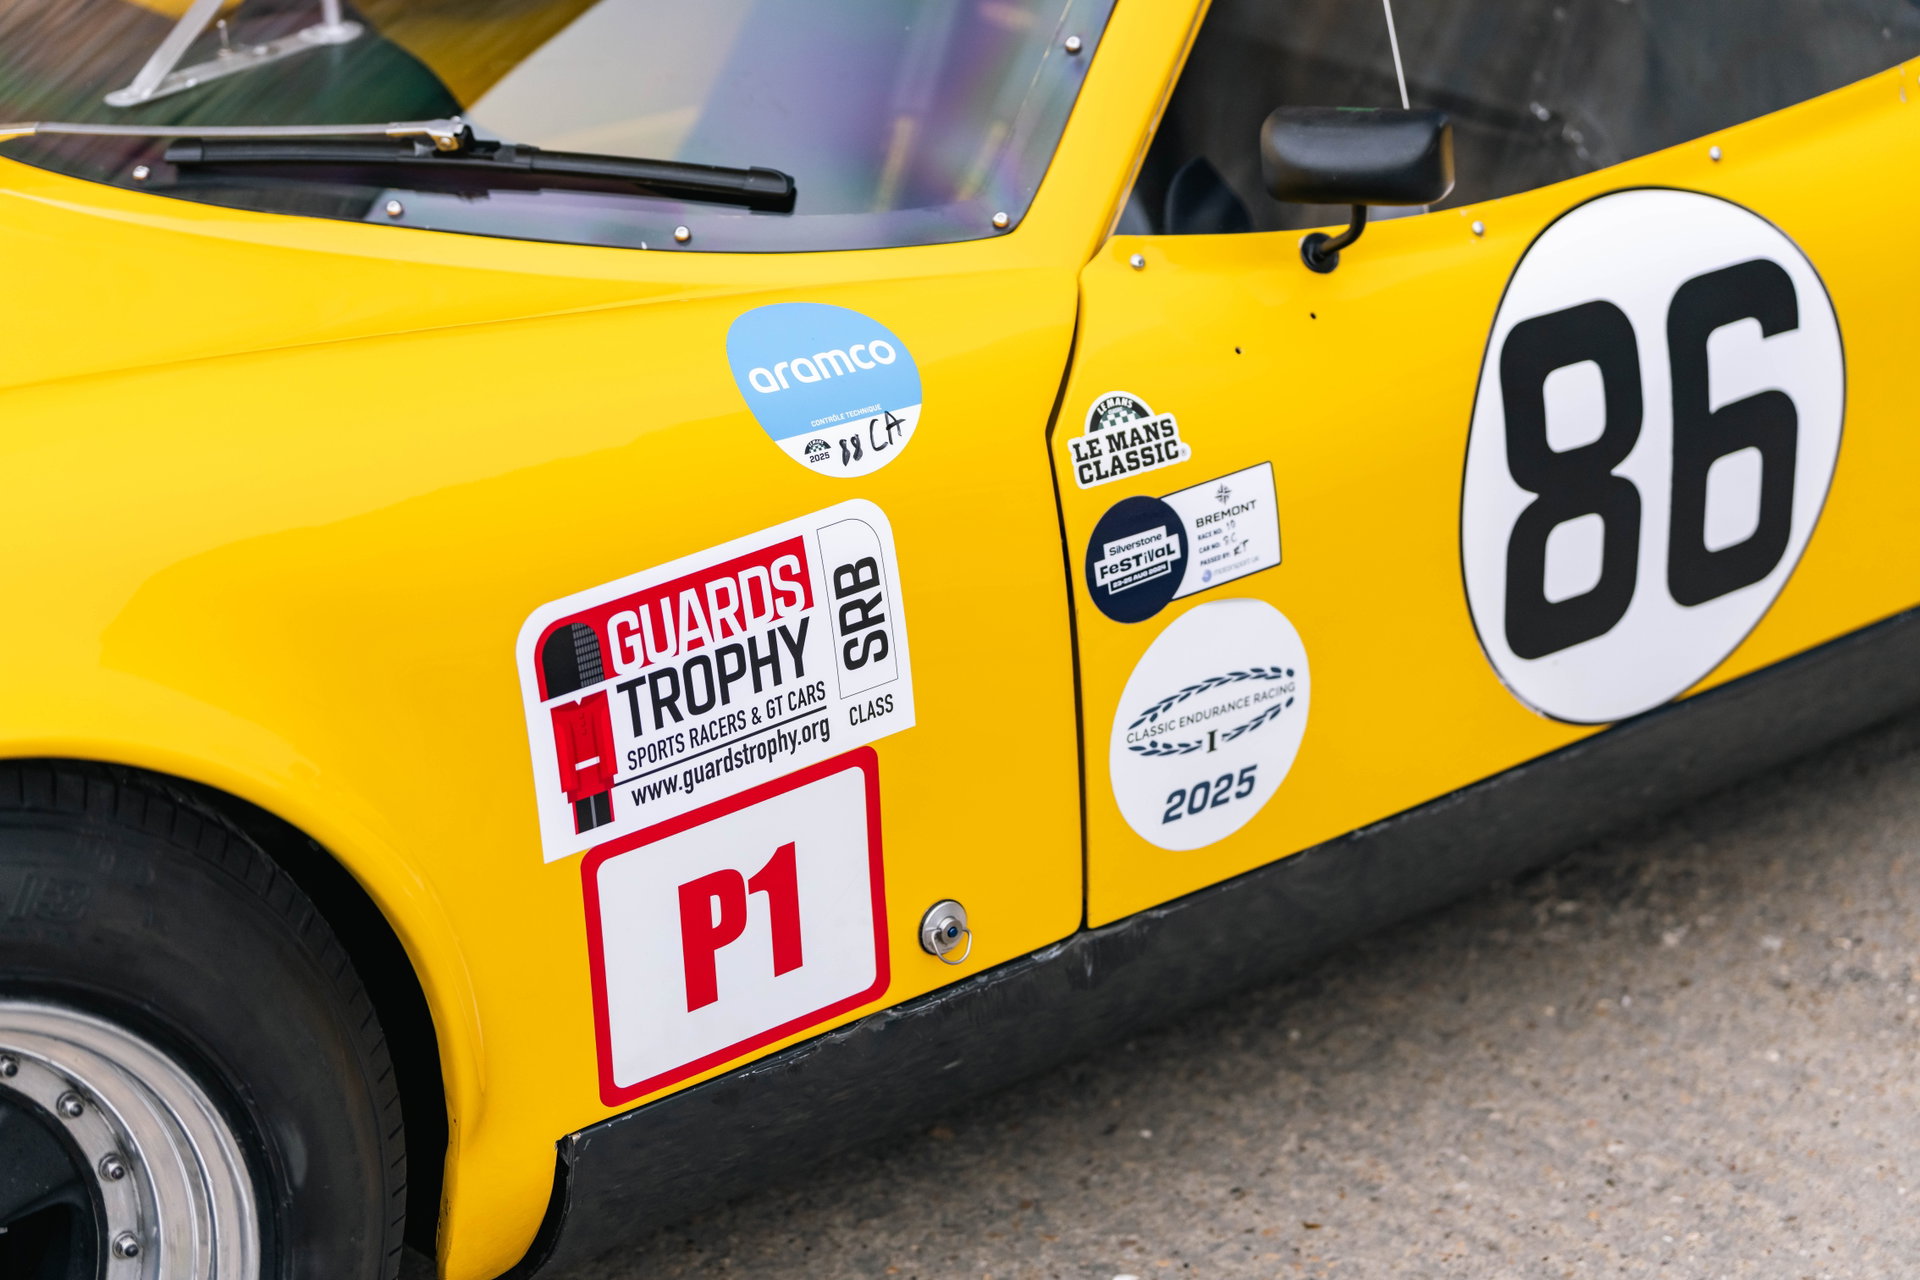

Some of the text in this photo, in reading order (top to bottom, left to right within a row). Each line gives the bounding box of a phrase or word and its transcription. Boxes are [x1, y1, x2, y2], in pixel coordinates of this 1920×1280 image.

[748, 339, 897, 394] aramco
[810, 403, 882, 428] CONTRÔLE TECHNIQUE
[1096, 402, 1108, 416] LE
[1106, 397, 1134, 410] MANS
[869, 410, 907, 452] CA
[1072, 418, 1175, 463] LE MANS
[809, 451, 830, 463] 2025
[1078, 439, 1179, 485] CLASSIC
[1499, 257, 1800, 661] 86
[1195, 499, 1257, 528] BREMONT
[1109, 533, 1162, 556] Silverstone
[1133, 571, 1148, 581] AUG
[606, 553, 807, 677] GUARDS
[832, 555, 889, 672] SRB
[615, 615, 810, 739] TROPHY
[627, 680, 827, 771] SPORTS RACERS & GT CARS
[848, 694, 895, 728] CLASS
[1126, 681, 1296, 745] CLASSIC ENDURANCE RACING
[630, 715, 831, 808] www.guardstrophy.org
[1206, 729, 1219, 753] I
[1161, 763, 1258, 825] 2025
[677, 840, 804, 1014] P1
